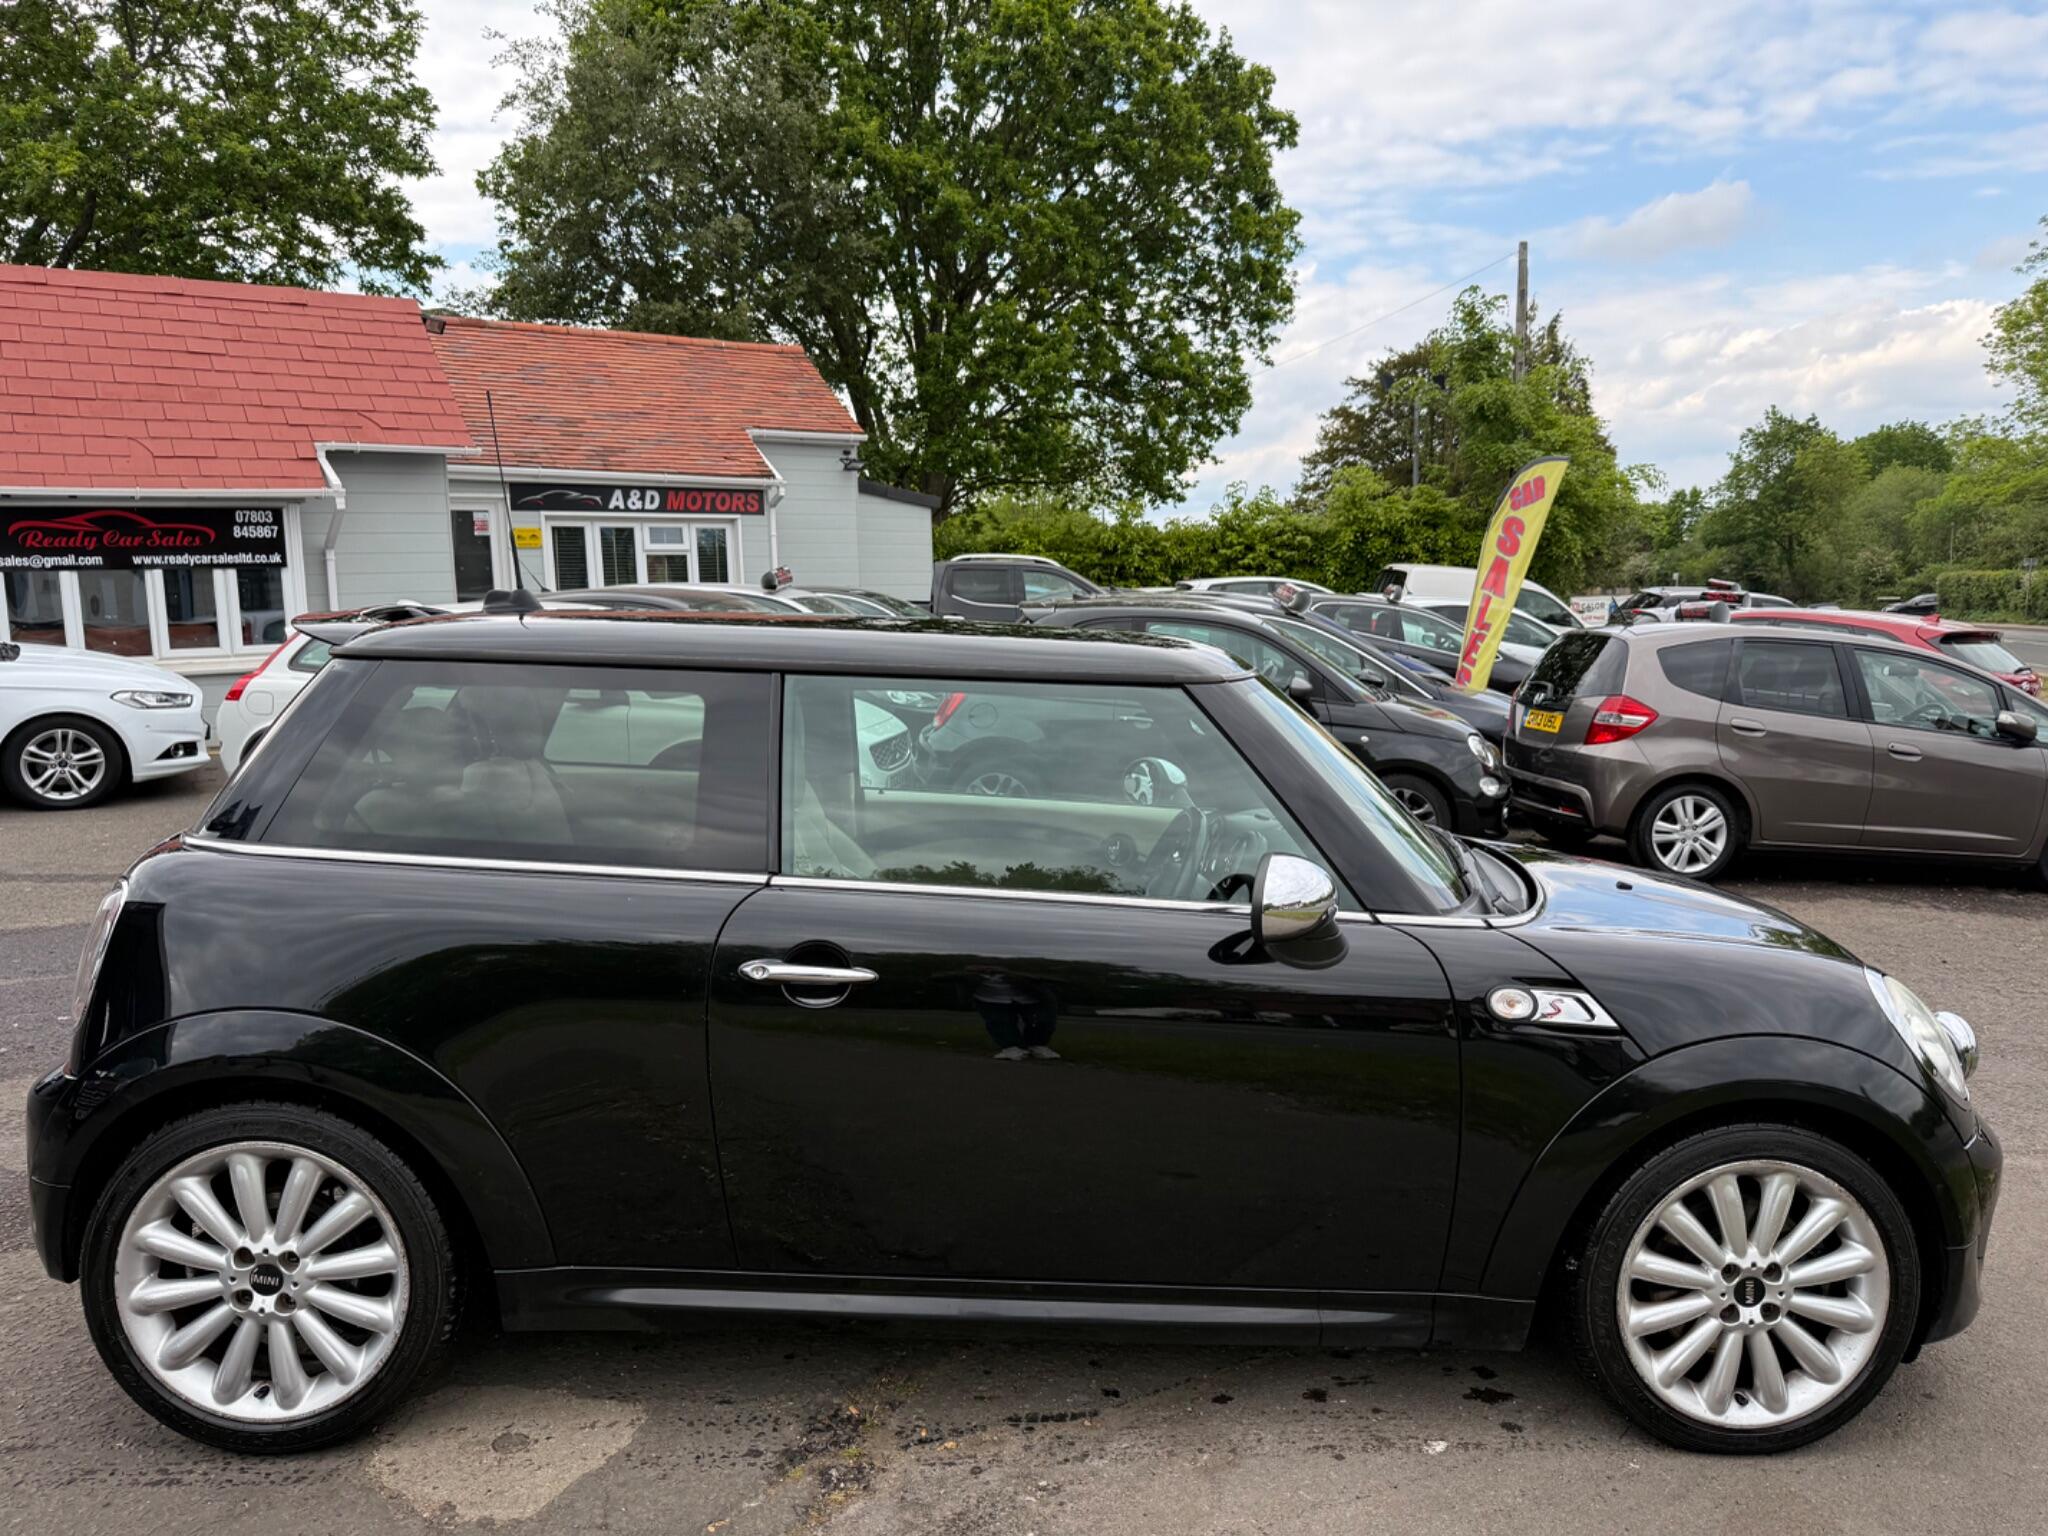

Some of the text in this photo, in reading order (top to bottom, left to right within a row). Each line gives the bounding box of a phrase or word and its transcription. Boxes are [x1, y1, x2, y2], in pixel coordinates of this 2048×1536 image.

[608, 489, 760, 513] A&D MOTORS
[235, 510, 273, 523] 07803
[233, 525, 278, 538] 845867
[18, 529, 202, 550] Ready Car Sales
[132, 552, 282, 566] www.readycarsalesltd.co.uk
[253, 1274, 279, 1287] MINI
[1745, 1280, 1755, 1304] MINI
